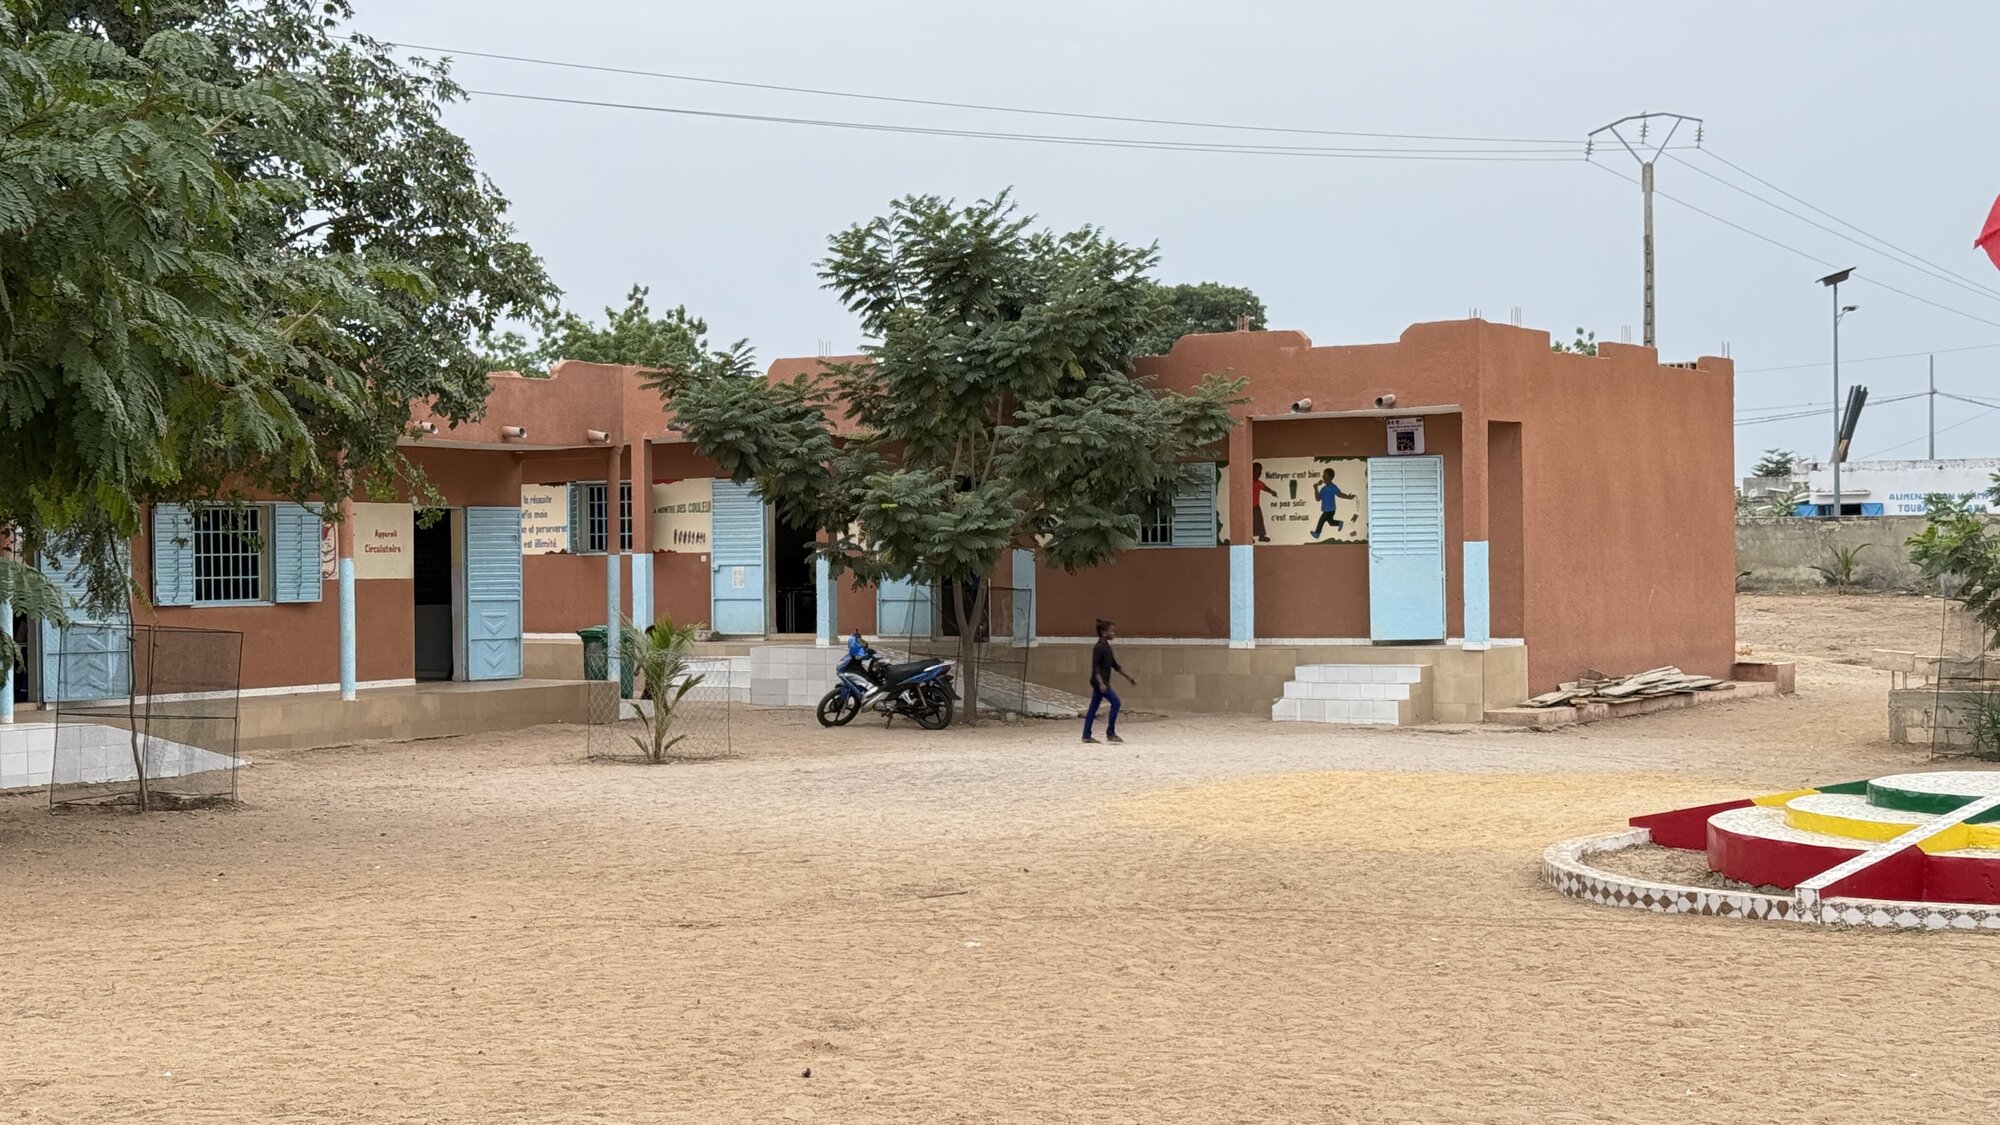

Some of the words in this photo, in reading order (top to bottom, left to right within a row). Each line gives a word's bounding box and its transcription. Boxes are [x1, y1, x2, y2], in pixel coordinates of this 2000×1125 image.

[1265, 471, 1291, 480] Nettoyer
[1308, 469, 1321, 478] bien
[676, 504, 686, 513] DES
[688, 500, 710, 513] COULEU
[1279, 501, 1291, 509] pas
[1292, 499, 1307, 508] salir
[1270, 514, 1286, 522] c'est
[1288, 512, 1310, 522] mieux
[374, 528, 398, 539] Appareil
[364, 544, 402, 553] Circulatoire
